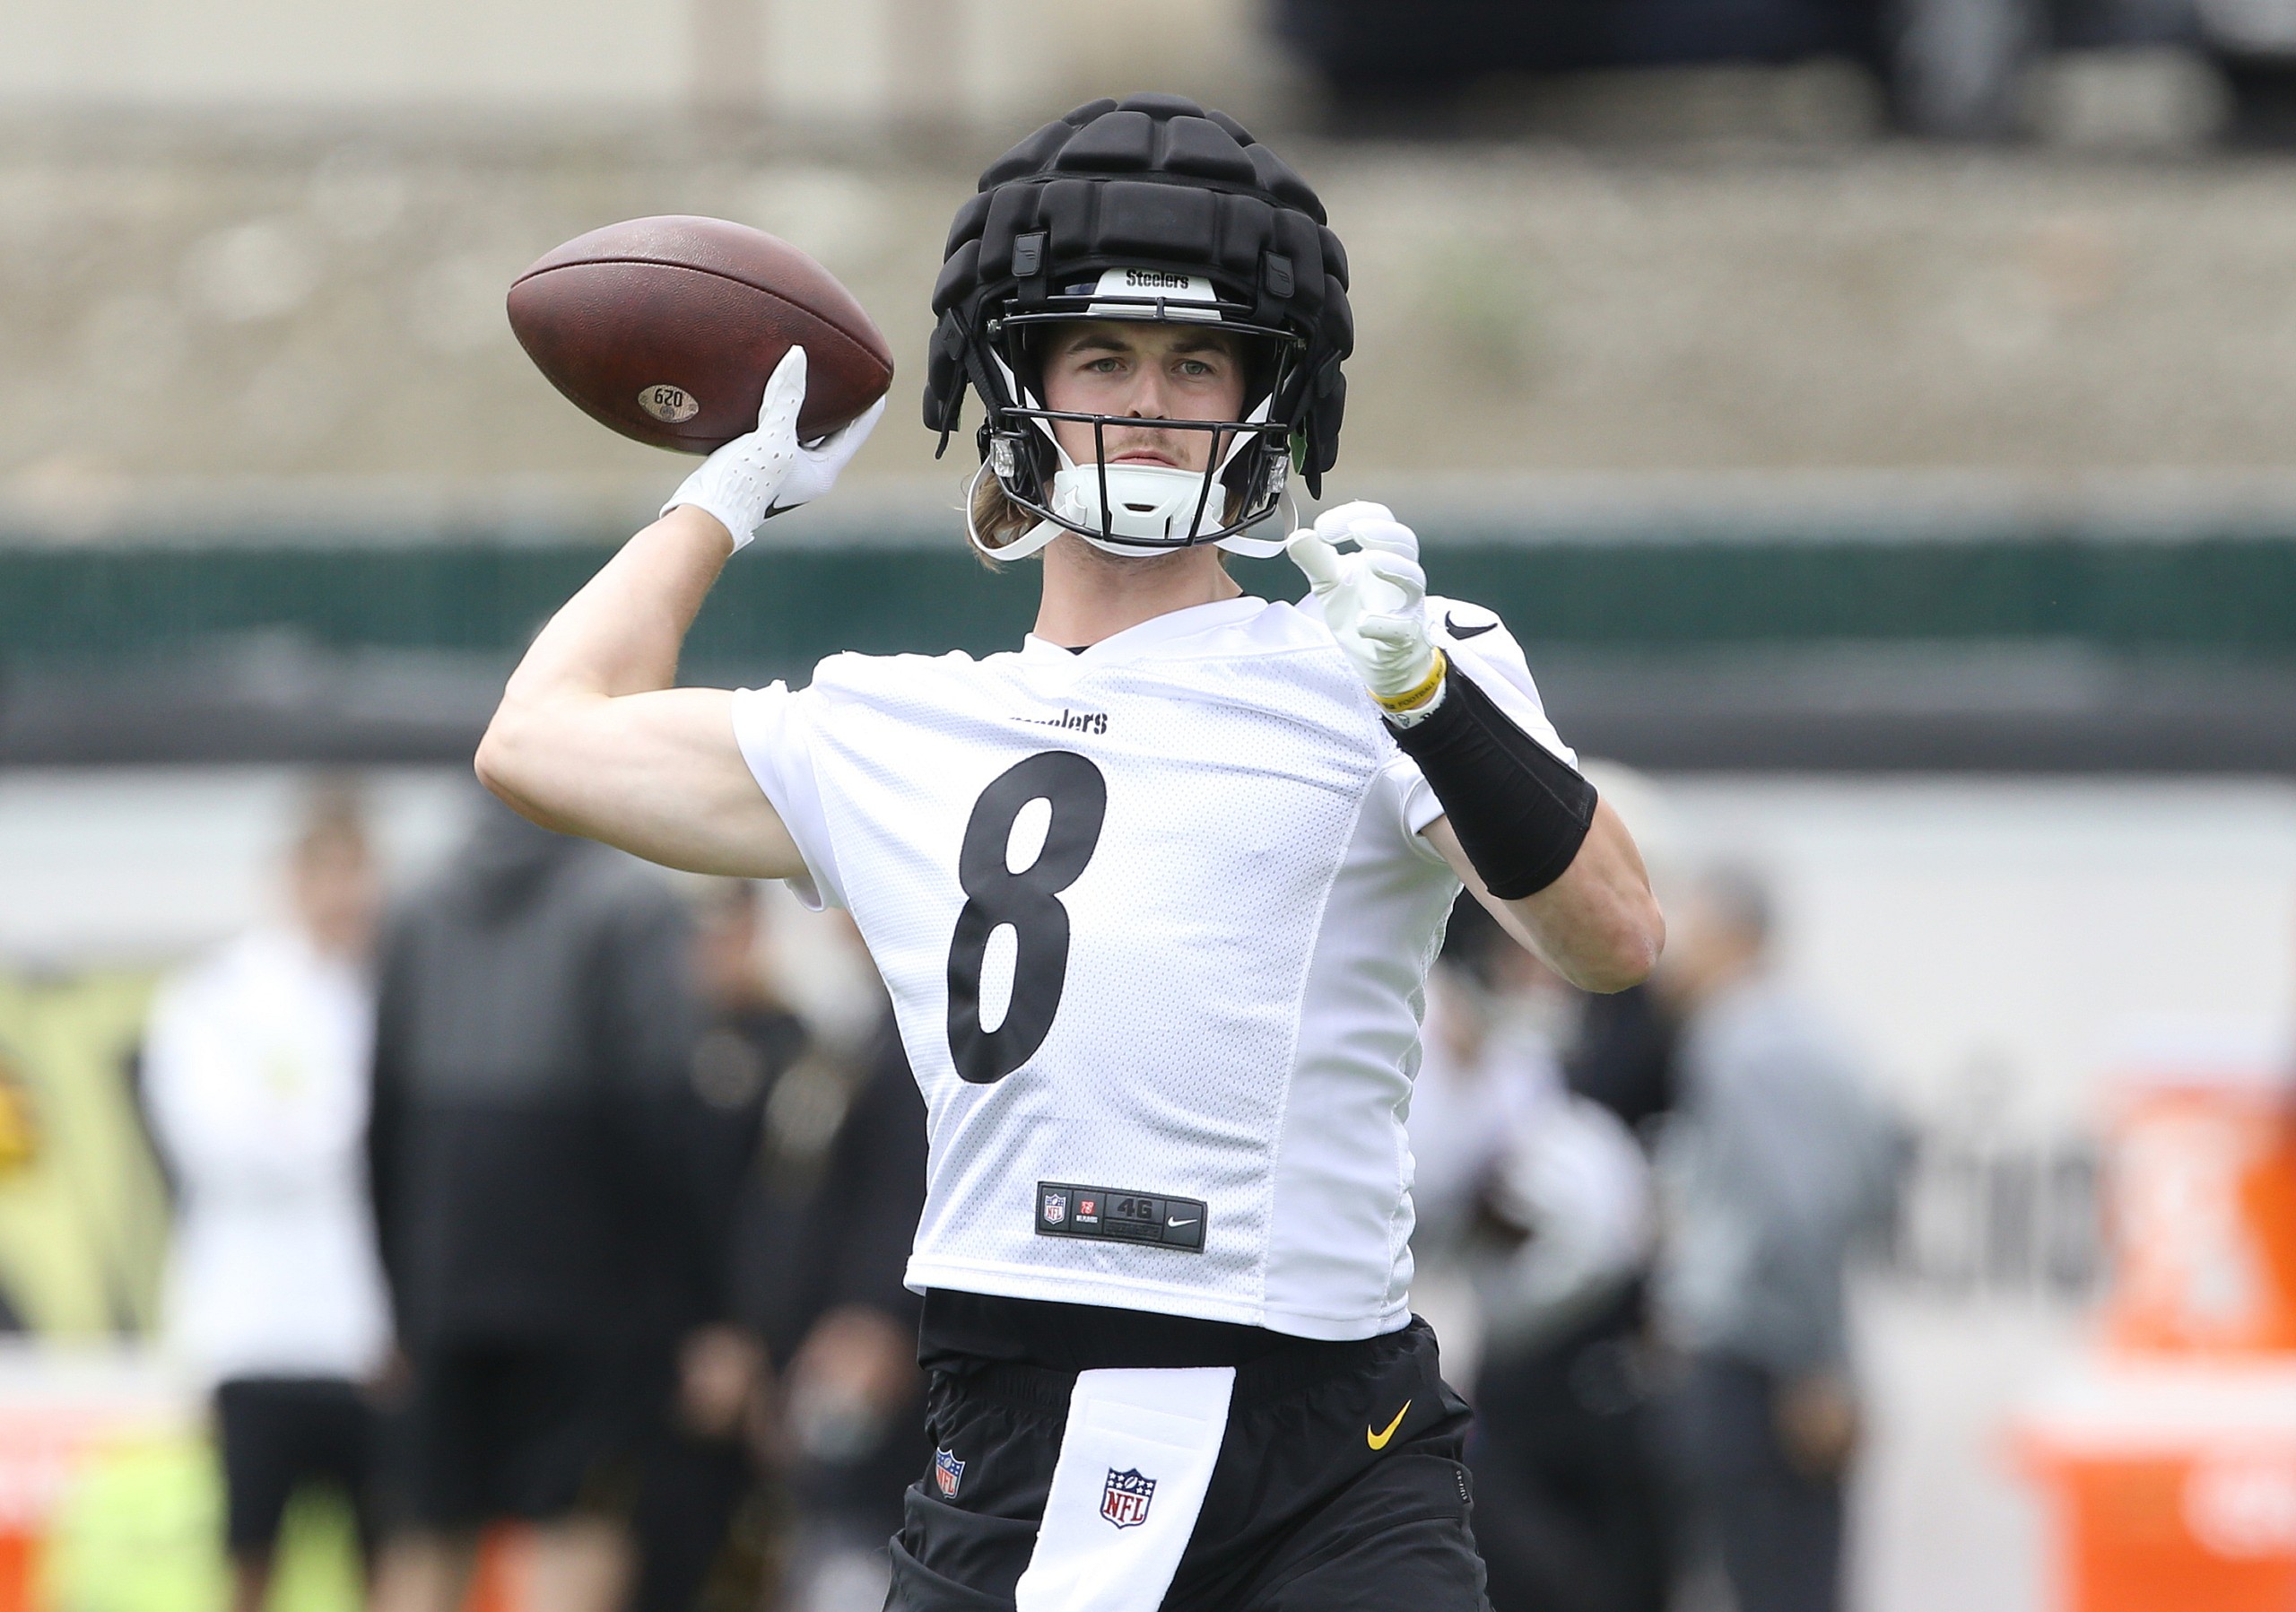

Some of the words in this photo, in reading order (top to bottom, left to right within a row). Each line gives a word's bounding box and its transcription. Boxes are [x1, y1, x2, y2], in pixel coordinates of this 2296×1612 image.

[1126, 268, 1189, 290] Steelers
[947, 750, 1107, 1085] 8
[1047, 1207, 1062, 1219] NFL
[937, 1467, 955, 1494] NFL
[1103, 1490, 1144, 1522] NFL
